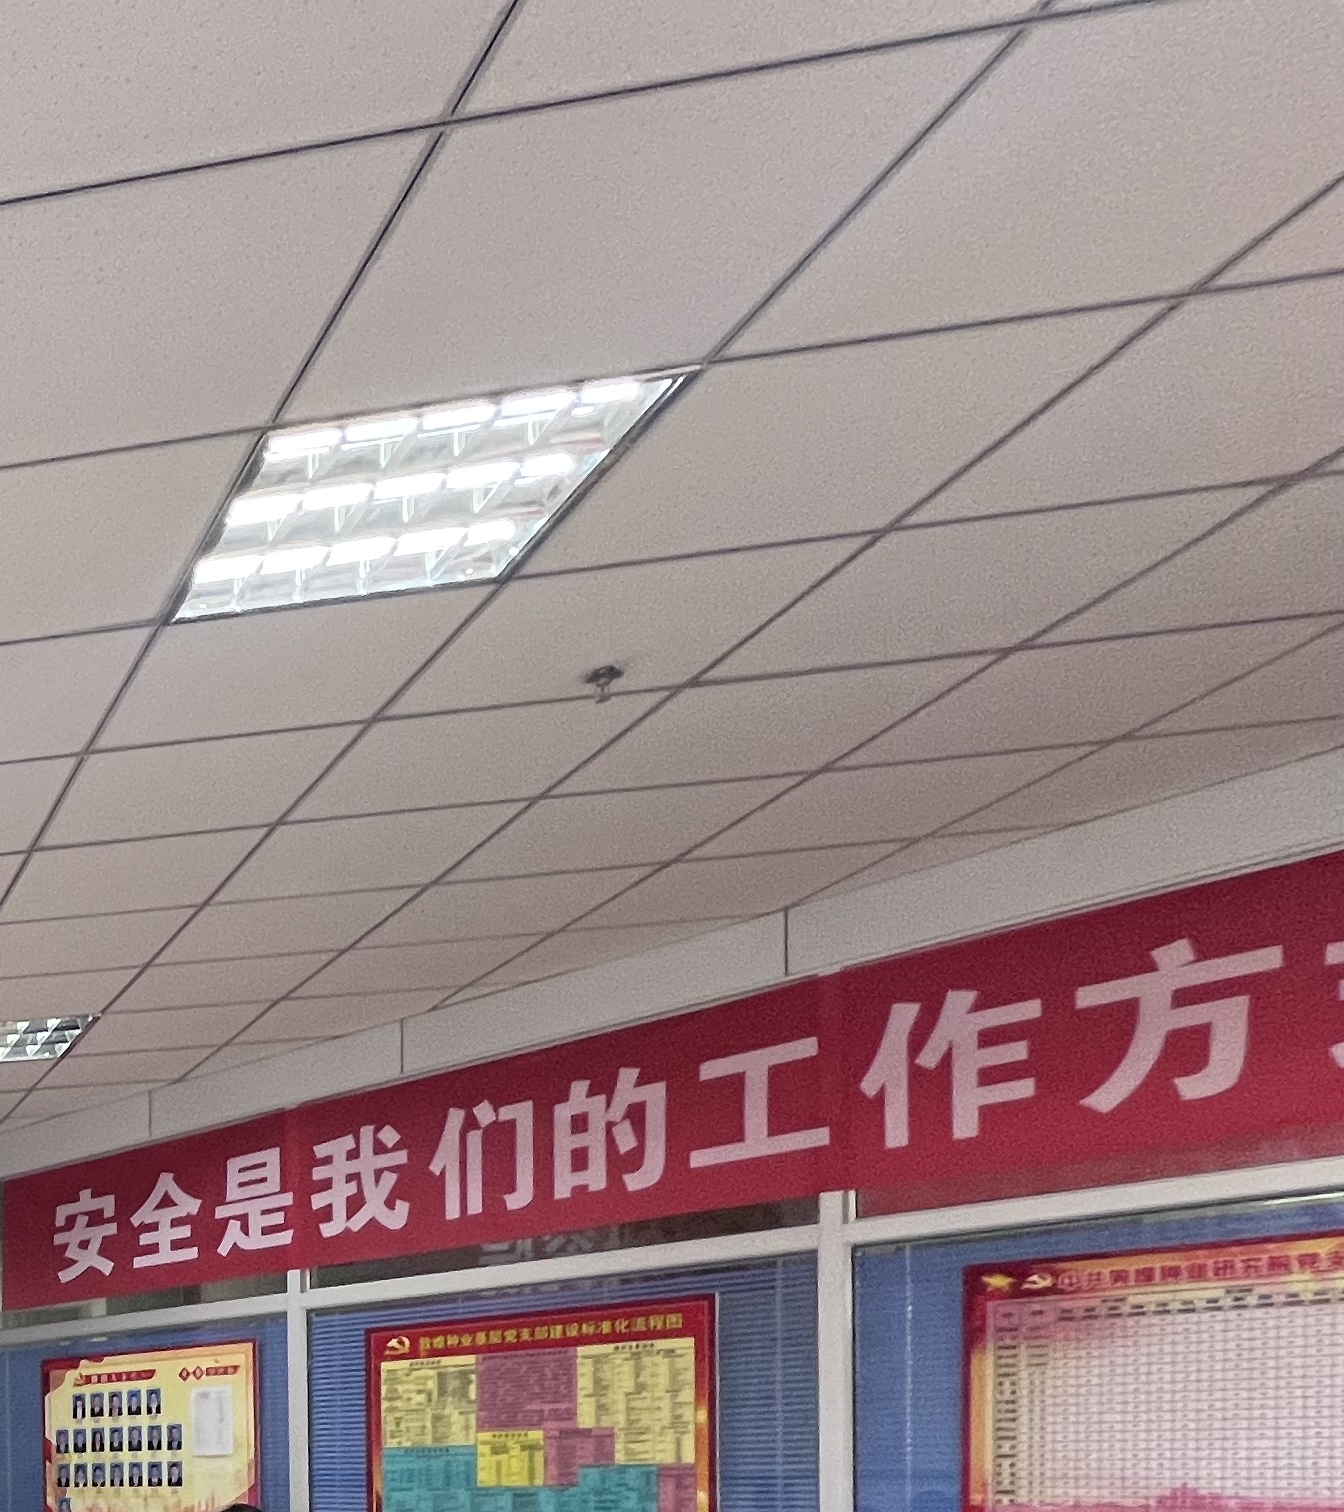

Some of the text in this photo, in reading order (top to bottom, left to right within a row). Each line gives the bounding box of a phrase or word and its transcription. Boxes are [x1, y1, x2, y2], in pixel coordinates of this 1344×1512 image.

[53, 937, 1344, 1284] 安全是我们的工作方
